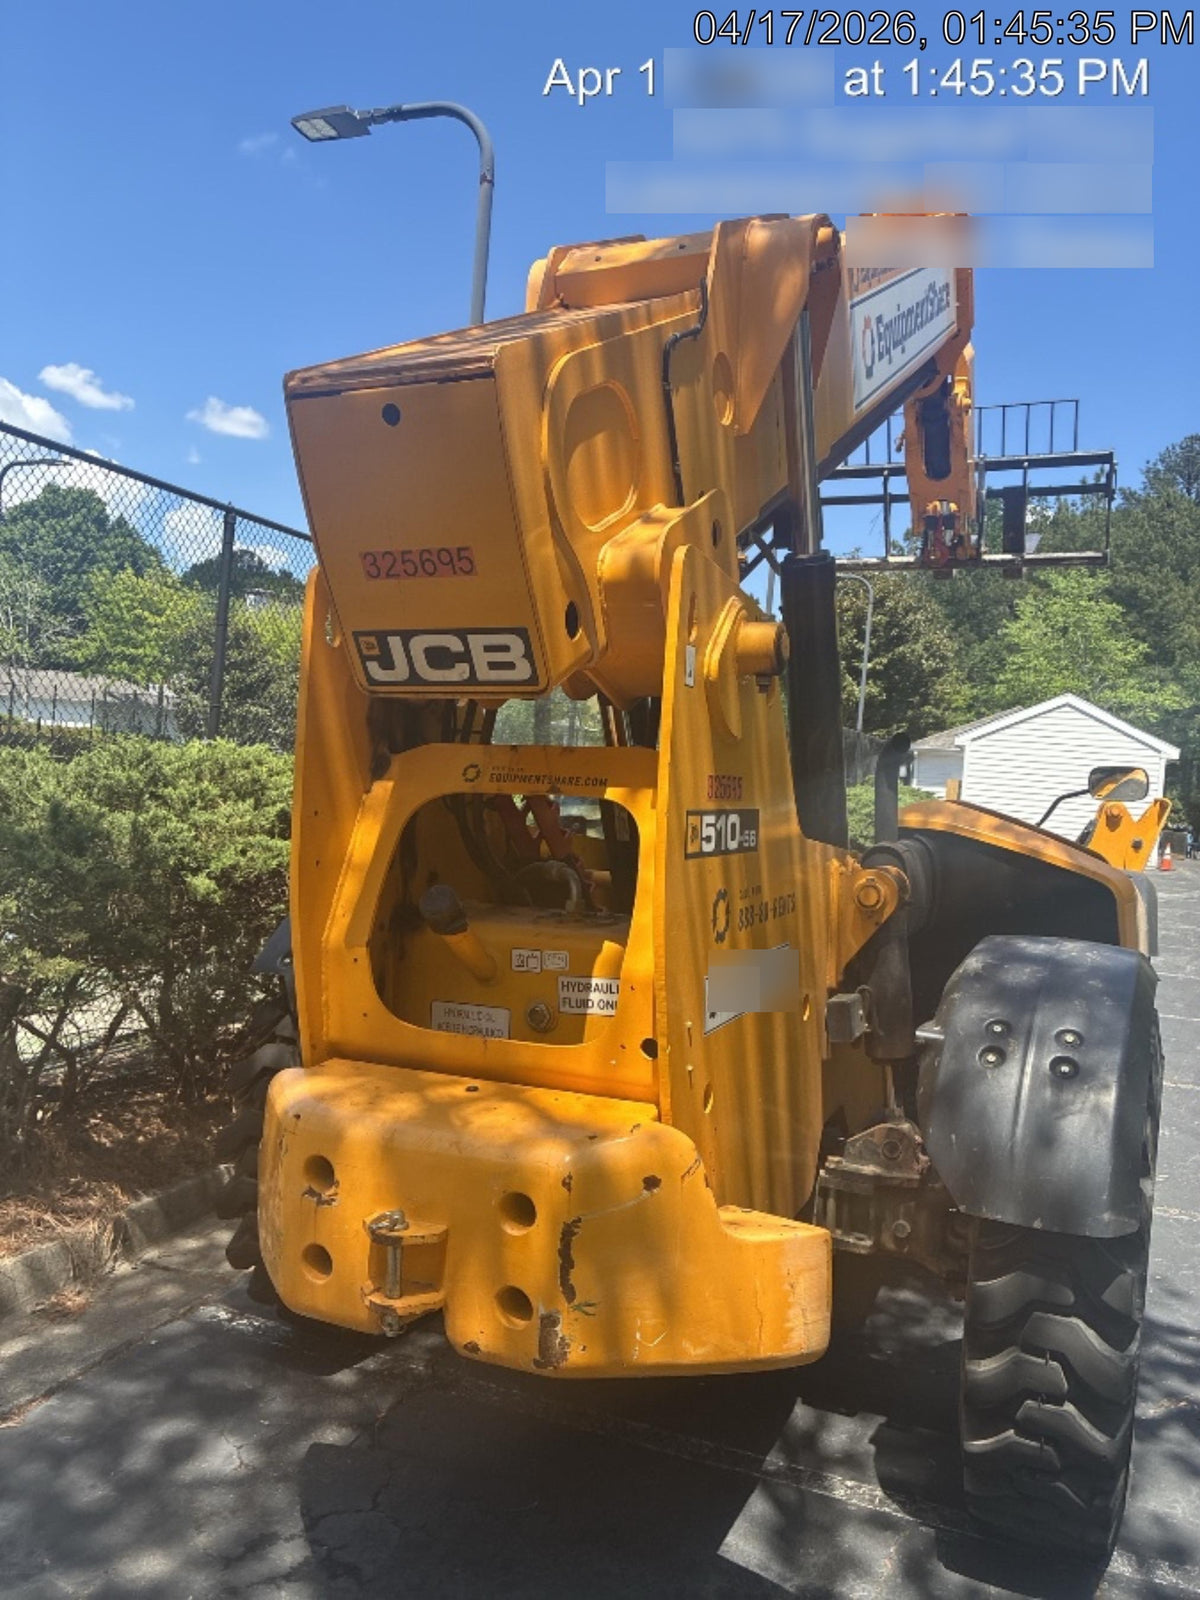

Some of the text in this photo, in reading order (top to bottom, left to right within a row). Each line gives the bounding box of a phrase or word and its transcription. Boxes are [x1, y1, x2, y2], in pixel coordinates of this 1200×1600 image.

[363, 547, 475, 579] 325695
[365, 633, 533, 682] JCB
[561, 981, 620, 995] HYDRAULI
[562, 997, 594, 1009] FLUID
